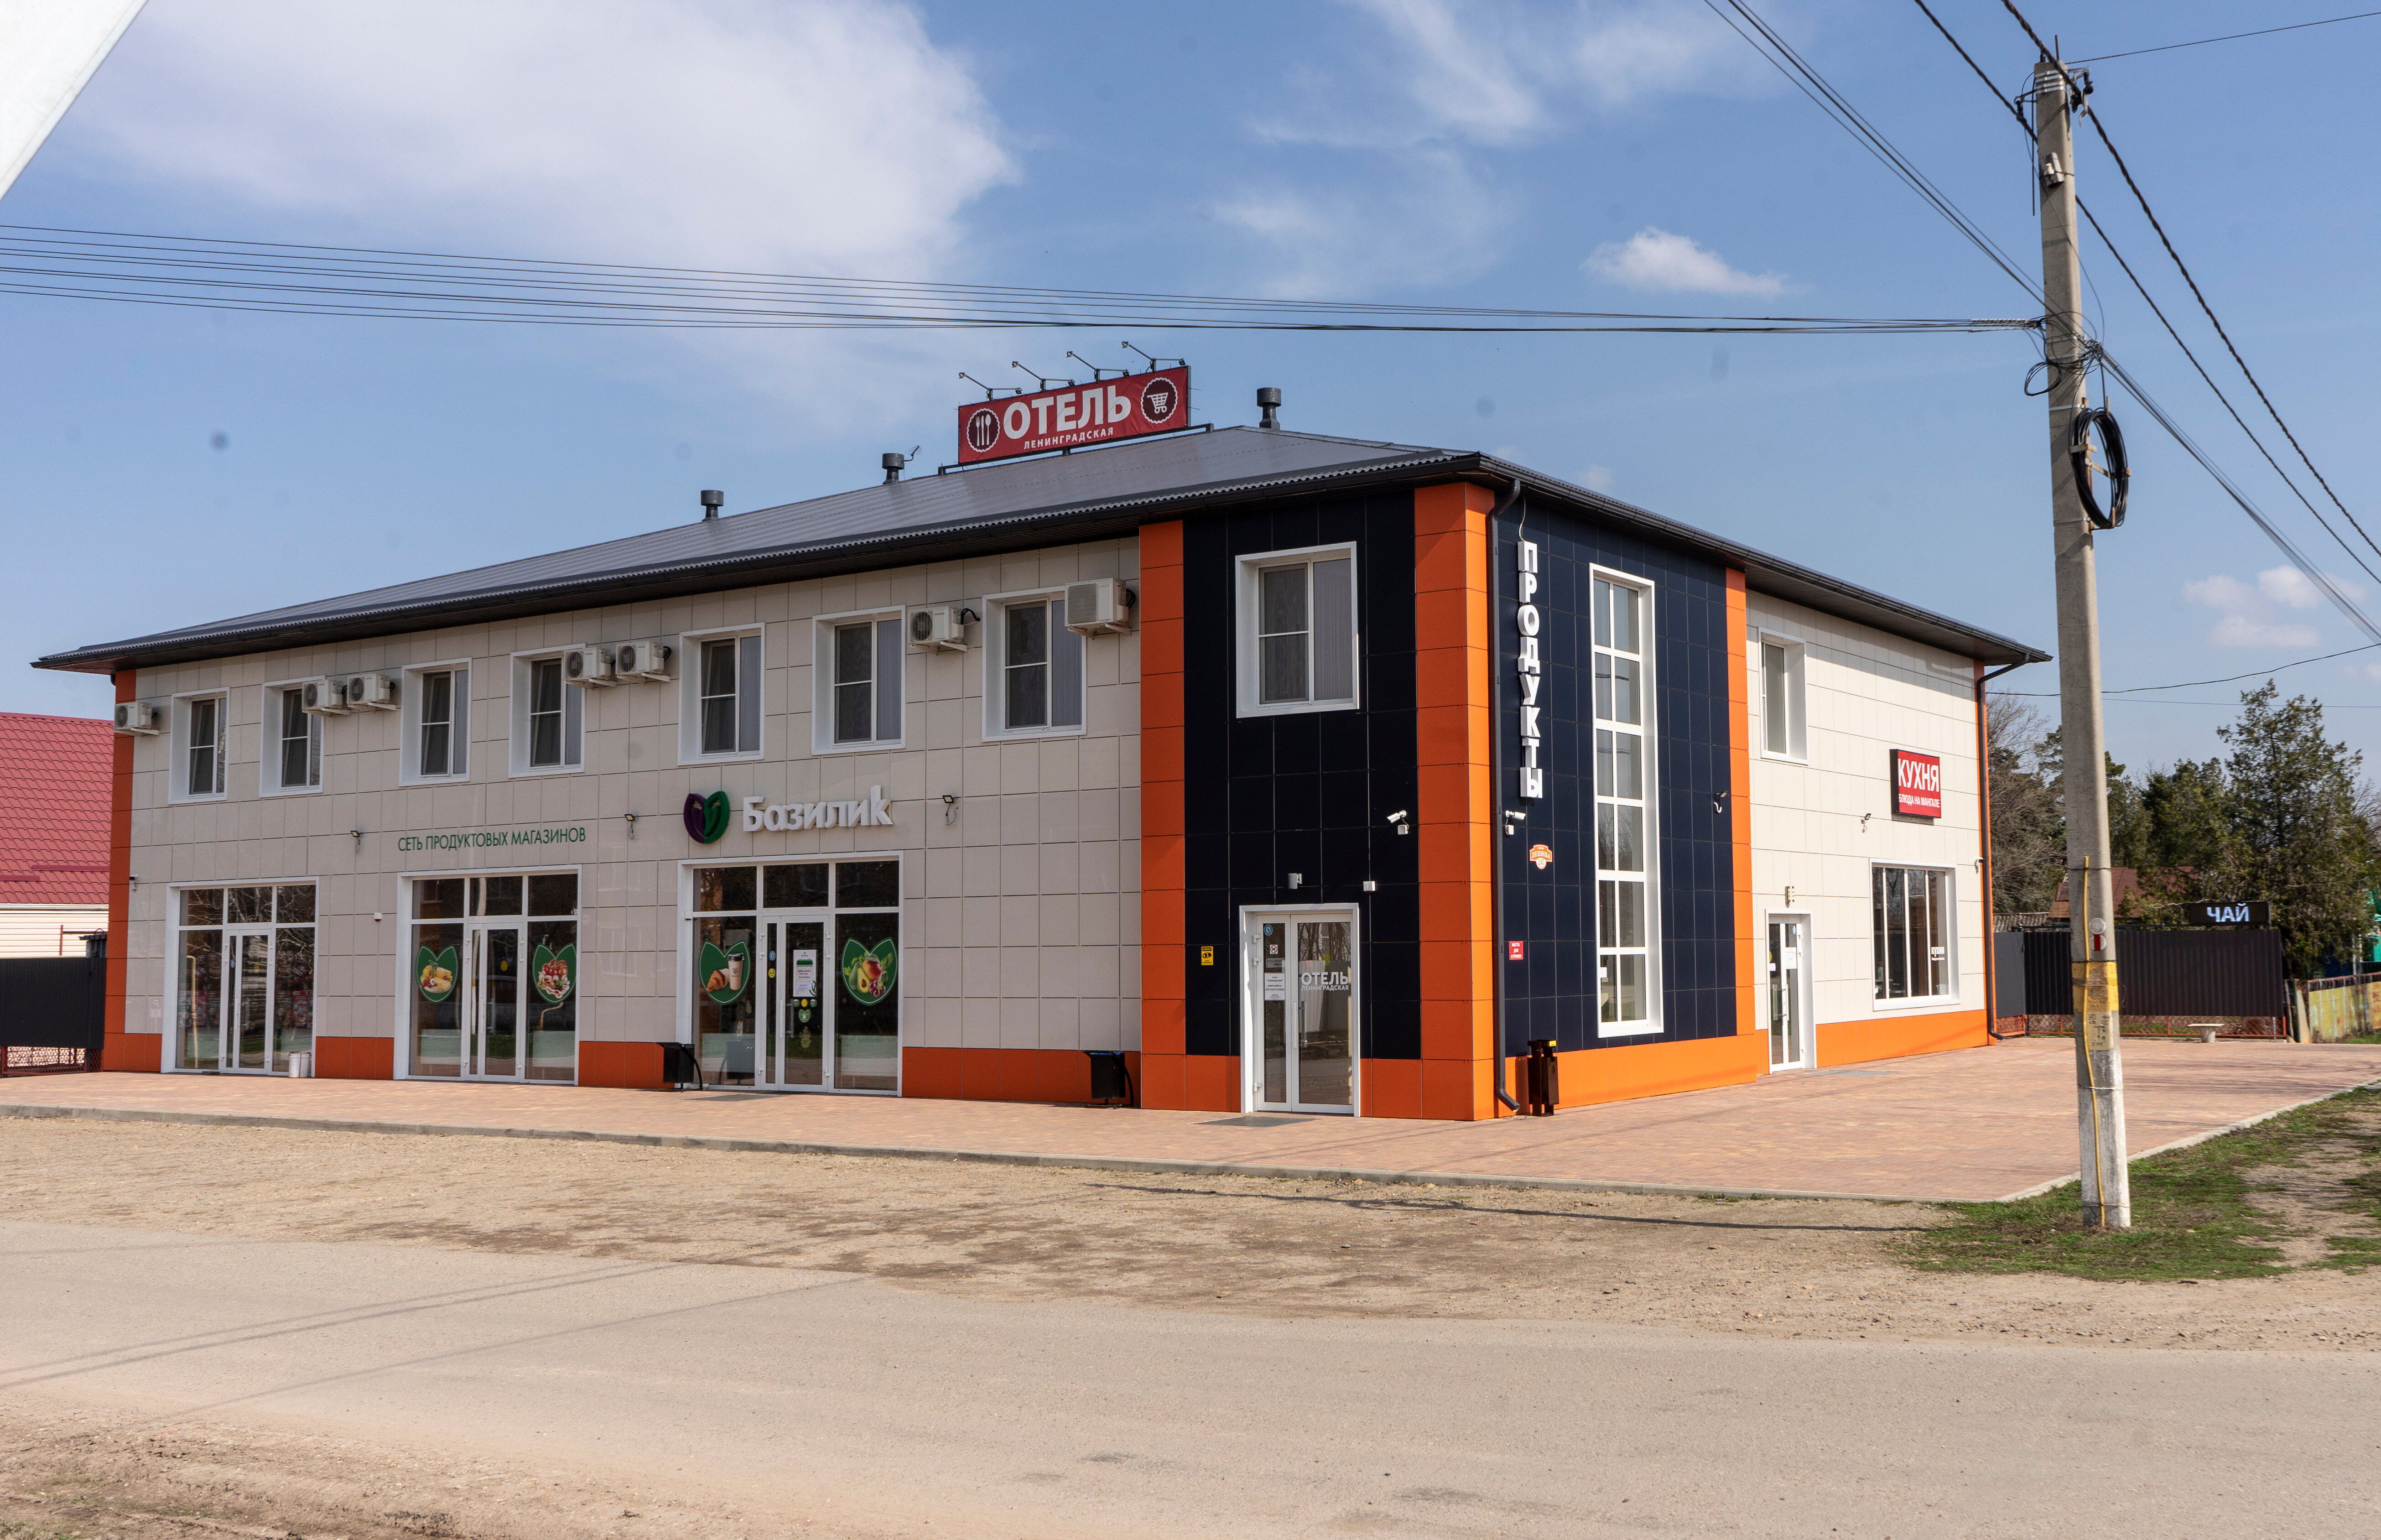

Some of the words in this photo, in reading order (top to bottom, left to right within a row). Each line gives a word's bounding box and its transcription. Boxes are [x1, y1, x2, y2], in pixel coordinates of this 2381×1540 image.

[1003, 385, 1131, 439] ОТЕЛЬ
[1024, 427, 1113, 450] ЛЕНИНГРАДСКАЯ
[1518, 541, 1543, 798] ПРОДУКТЫ
[1898, 758, 1939, 792] КУХНЯ
[1899, 794, 1914, 806] БЛЮДА
[1914, 796, 1921, 805] НА
[1920, 797, 1940, 808] МАНГАЛЕ
[398, 837, 422, 851] СЕТЬ
[426, 832, 508, 851] ПРОДУКТОВЫХ
[511, 827, 586, 845] МАГАЗИНОВ
[1531, 851, 1550, 859] ЛЕНИНА
[2207, 903, 2249, 922] ЧАЙ
[1301, 972, 1348, 985] ОТЕЛЬ
